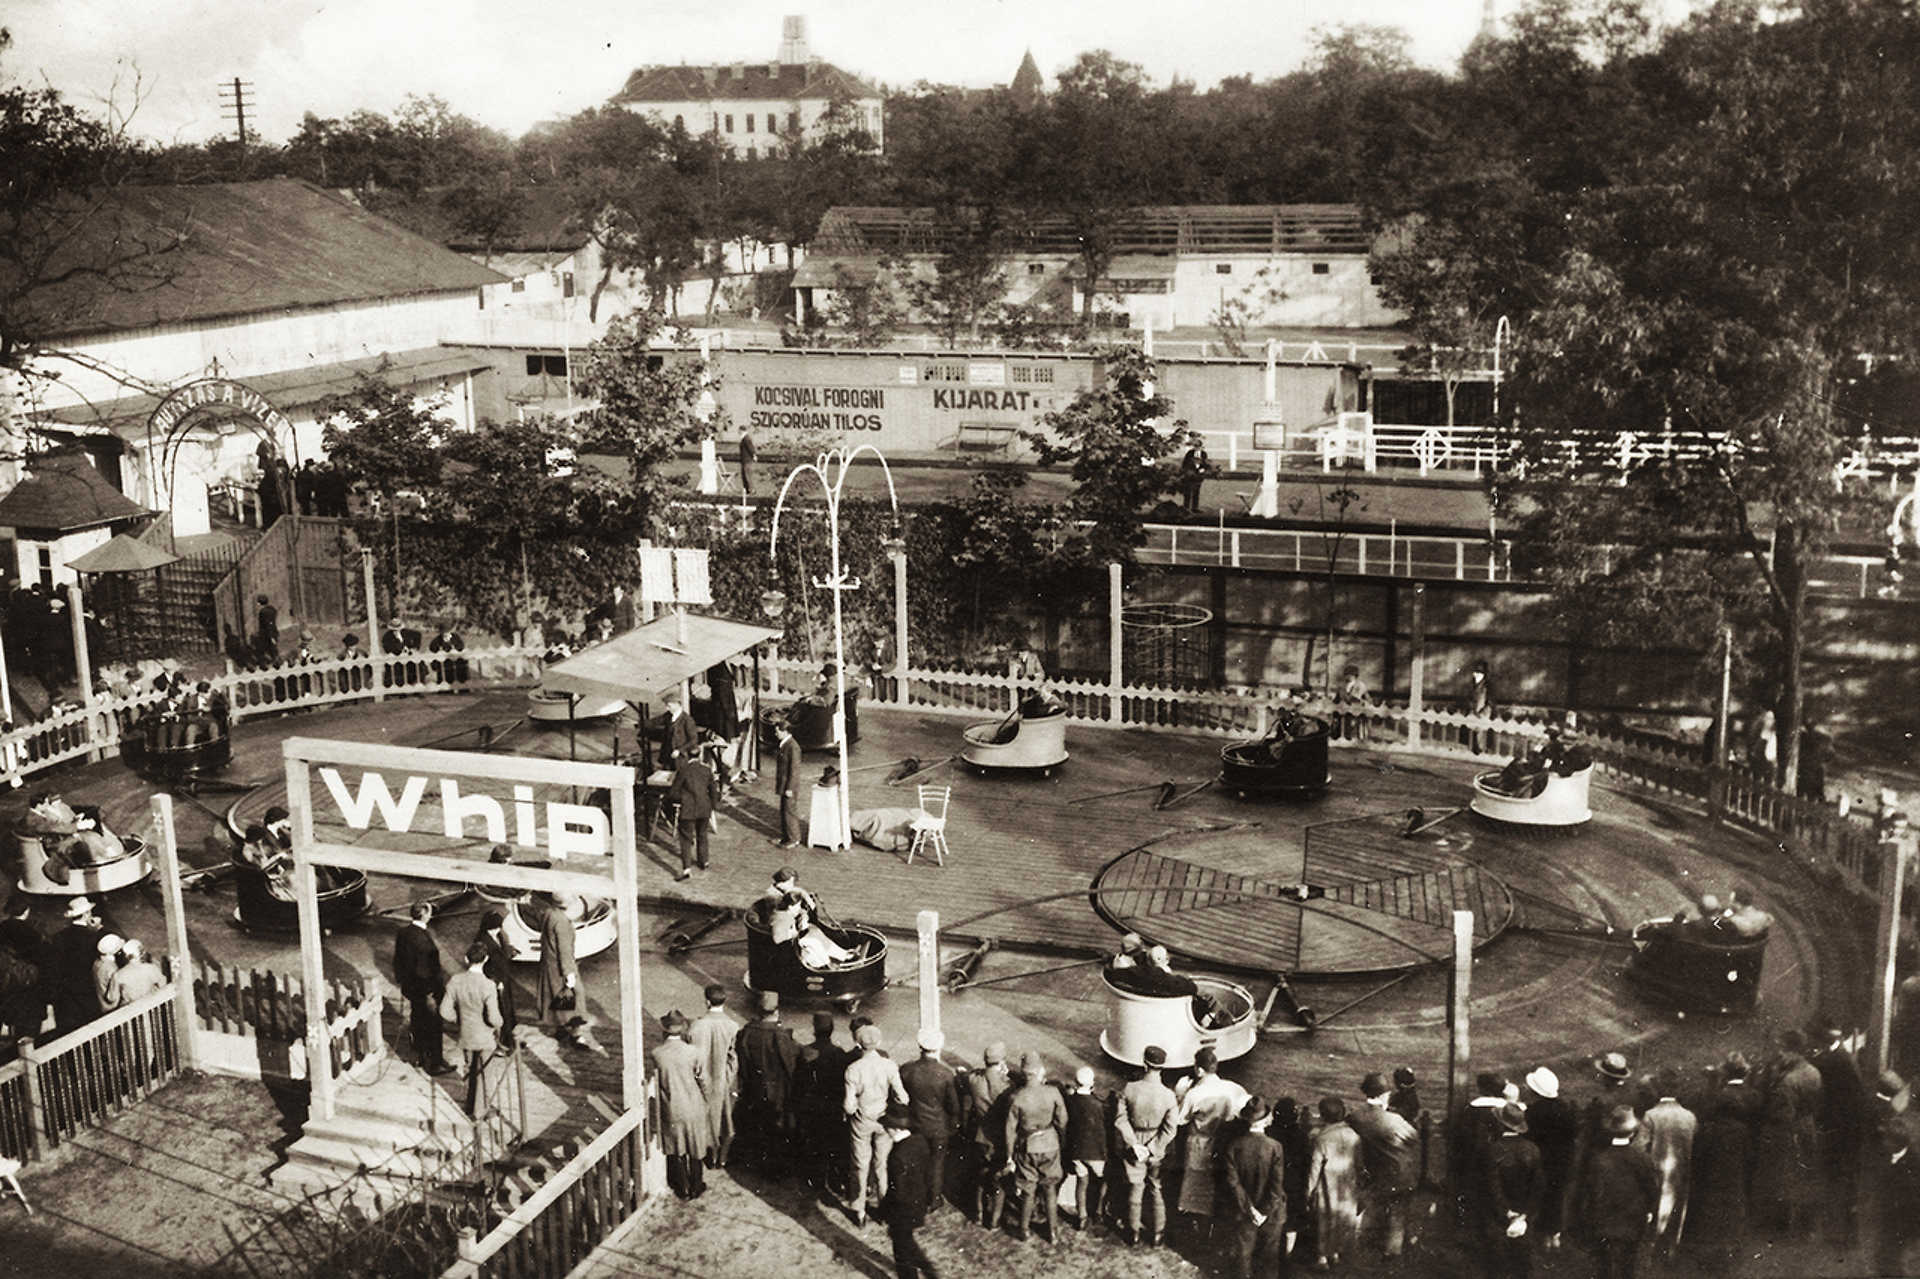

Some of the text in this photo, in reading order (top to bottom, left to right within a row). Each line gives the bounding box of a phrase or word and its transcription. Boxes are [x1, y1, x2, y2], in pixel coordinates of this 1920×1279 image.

[755, 386, 885, 409] KOCSIVAL FOROGNI
[834, 414, 883, 434] TILOS
[319, 767, 611, 859] Whip
